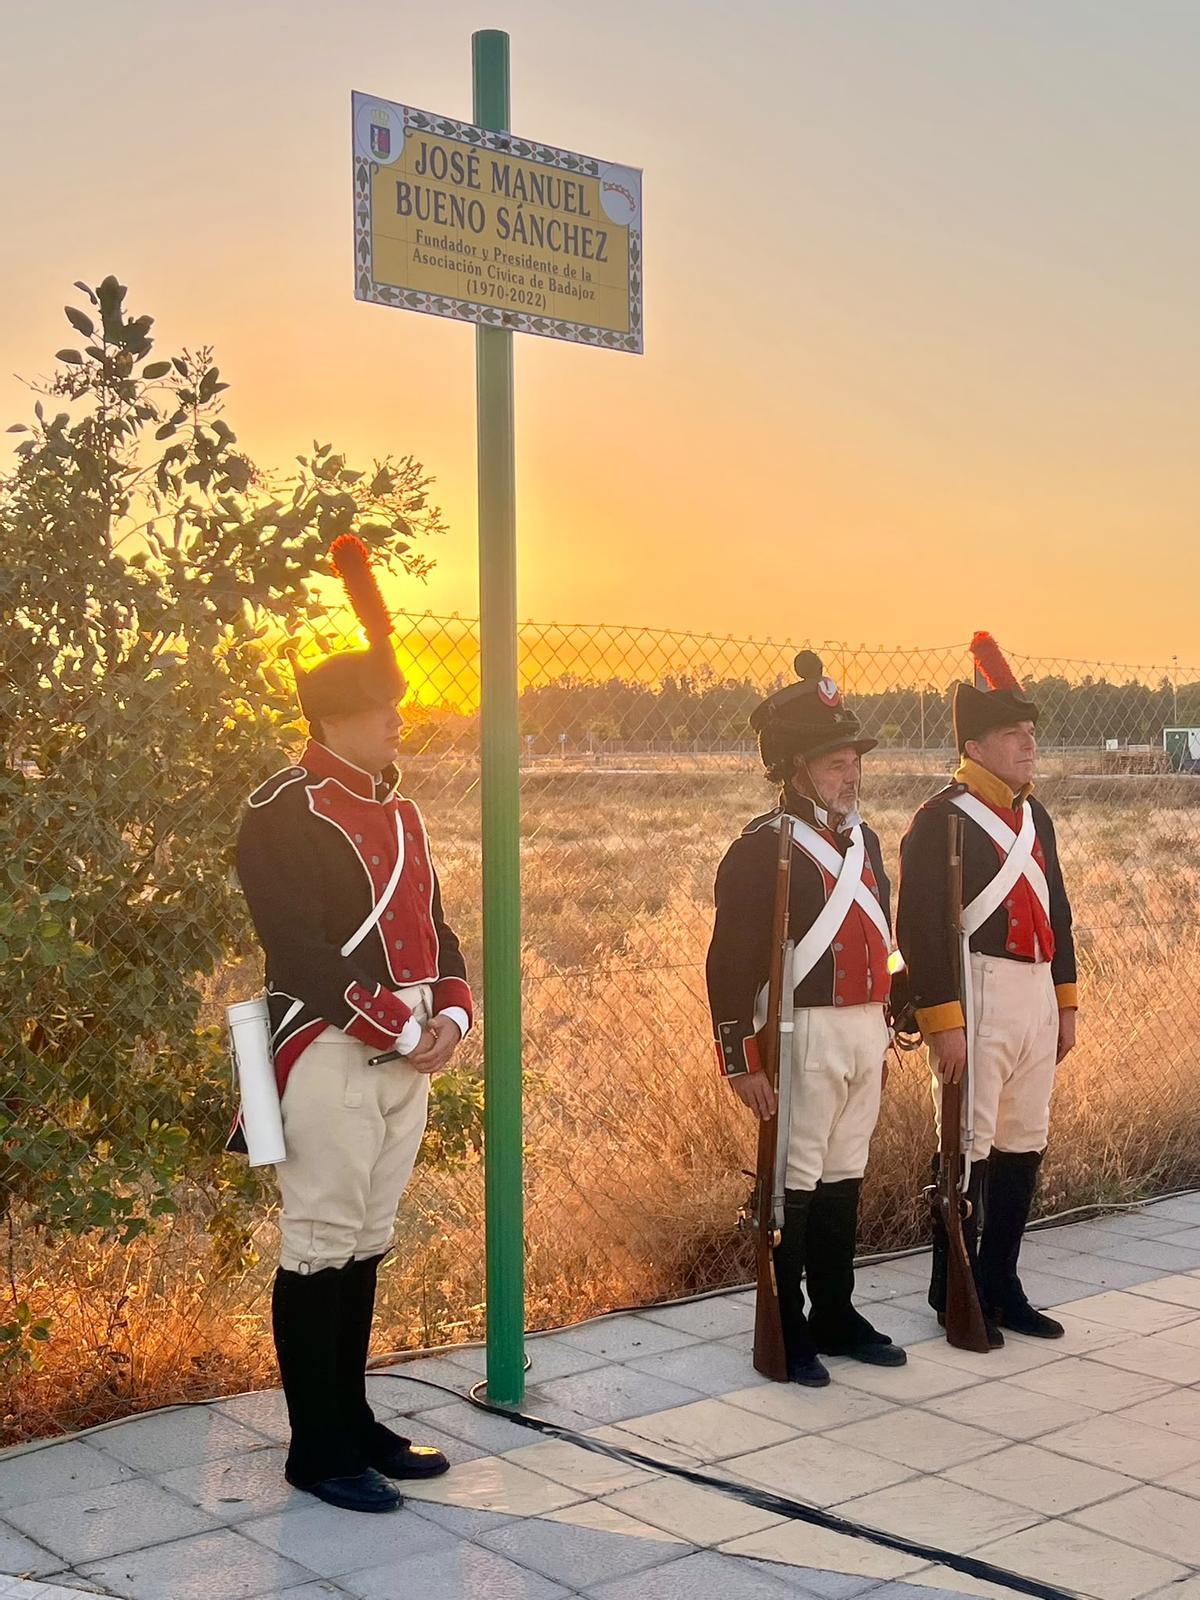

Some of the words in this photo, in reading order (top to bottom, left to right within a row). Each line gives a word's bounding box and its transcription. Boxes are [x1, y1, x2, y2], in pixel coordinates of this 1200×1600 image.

[415, 142, 481, 190] JOSÉ
[491, 160, 591, 217] MANUEL
[396, 180, 485, 234] BUENO
[496, 202, 608, 262] SÁNCHEZ
[412, 248, 482, 276] Asociación
[530, 274, 544, 290] de
[548, 279, 596, 301] Badajoz
[416, 229, 477, 256] Fundador
[482, 249, 489, 261] y
[493, 247, 559, 274] Presidente
[563, 262, 577, 279] de
[581, 266, 592, 282] la
[466, 281, 547, 310] (1970-2022)
